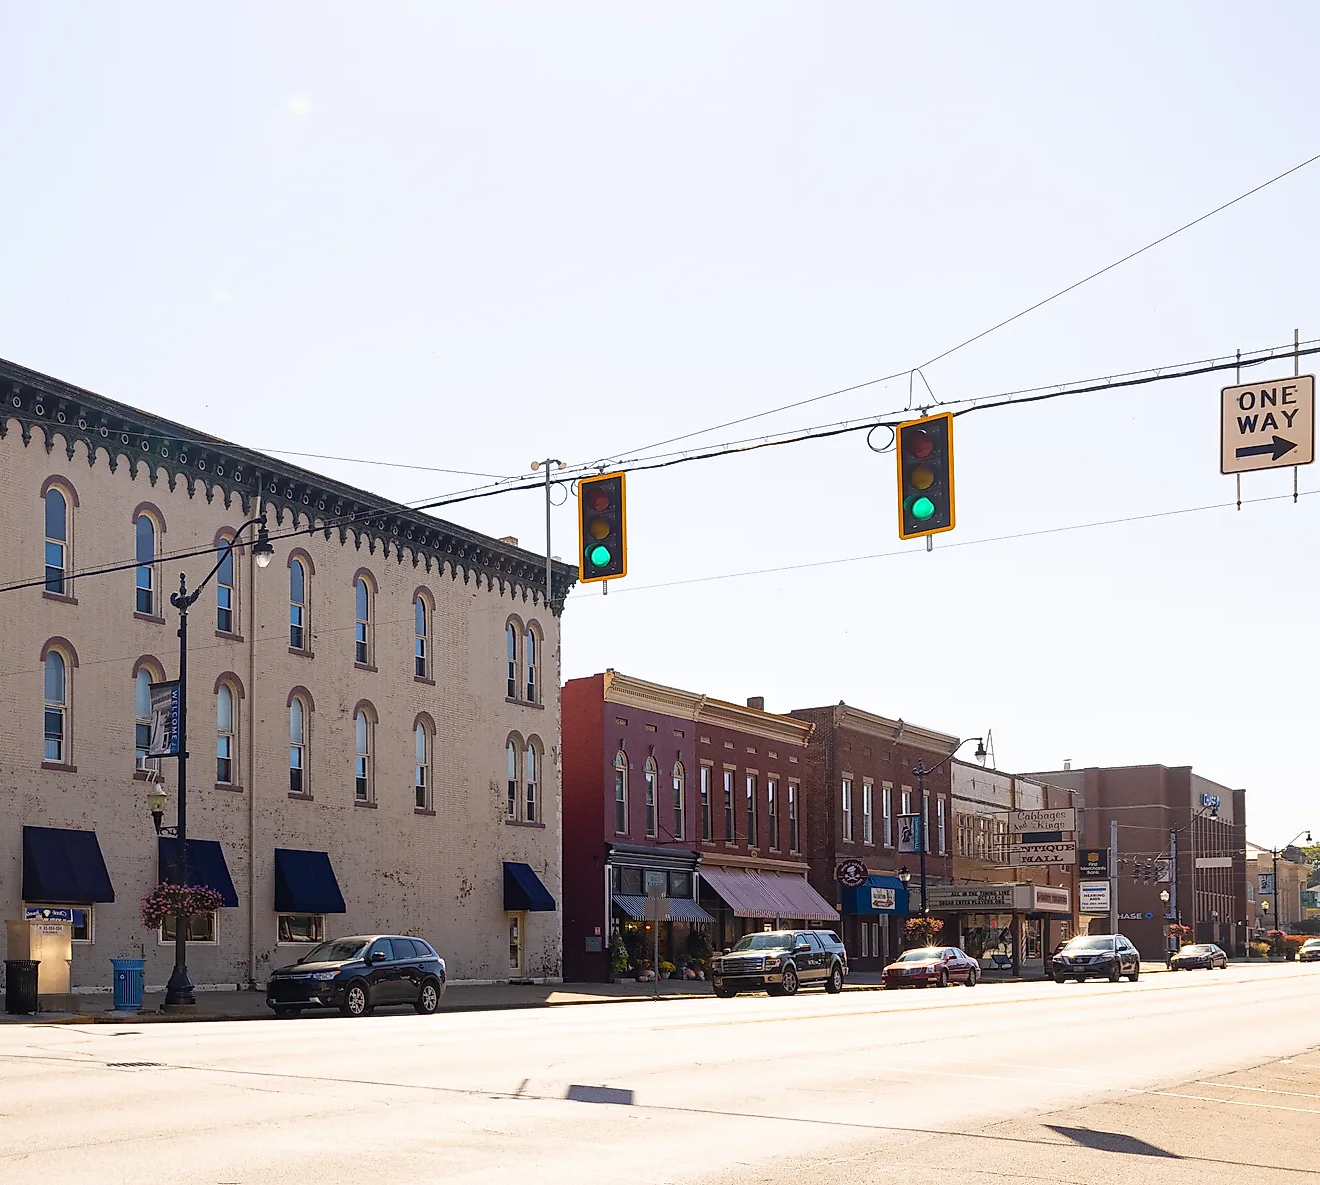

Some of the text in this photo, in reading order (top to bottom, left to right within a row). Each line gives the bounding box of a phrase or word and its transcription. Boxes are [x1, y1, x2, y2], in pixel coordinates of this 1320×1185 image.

[1239, 385, 1297, 411] ONE
[1236, 408, 1299, 435] WAY
[1017, 811, 1066, 821] Cabbages
[1014, 820, 1065, 831] And Kings
[1021, 855, 1064, 864] MALL
[1117, 912, 1143, 920] HASE
